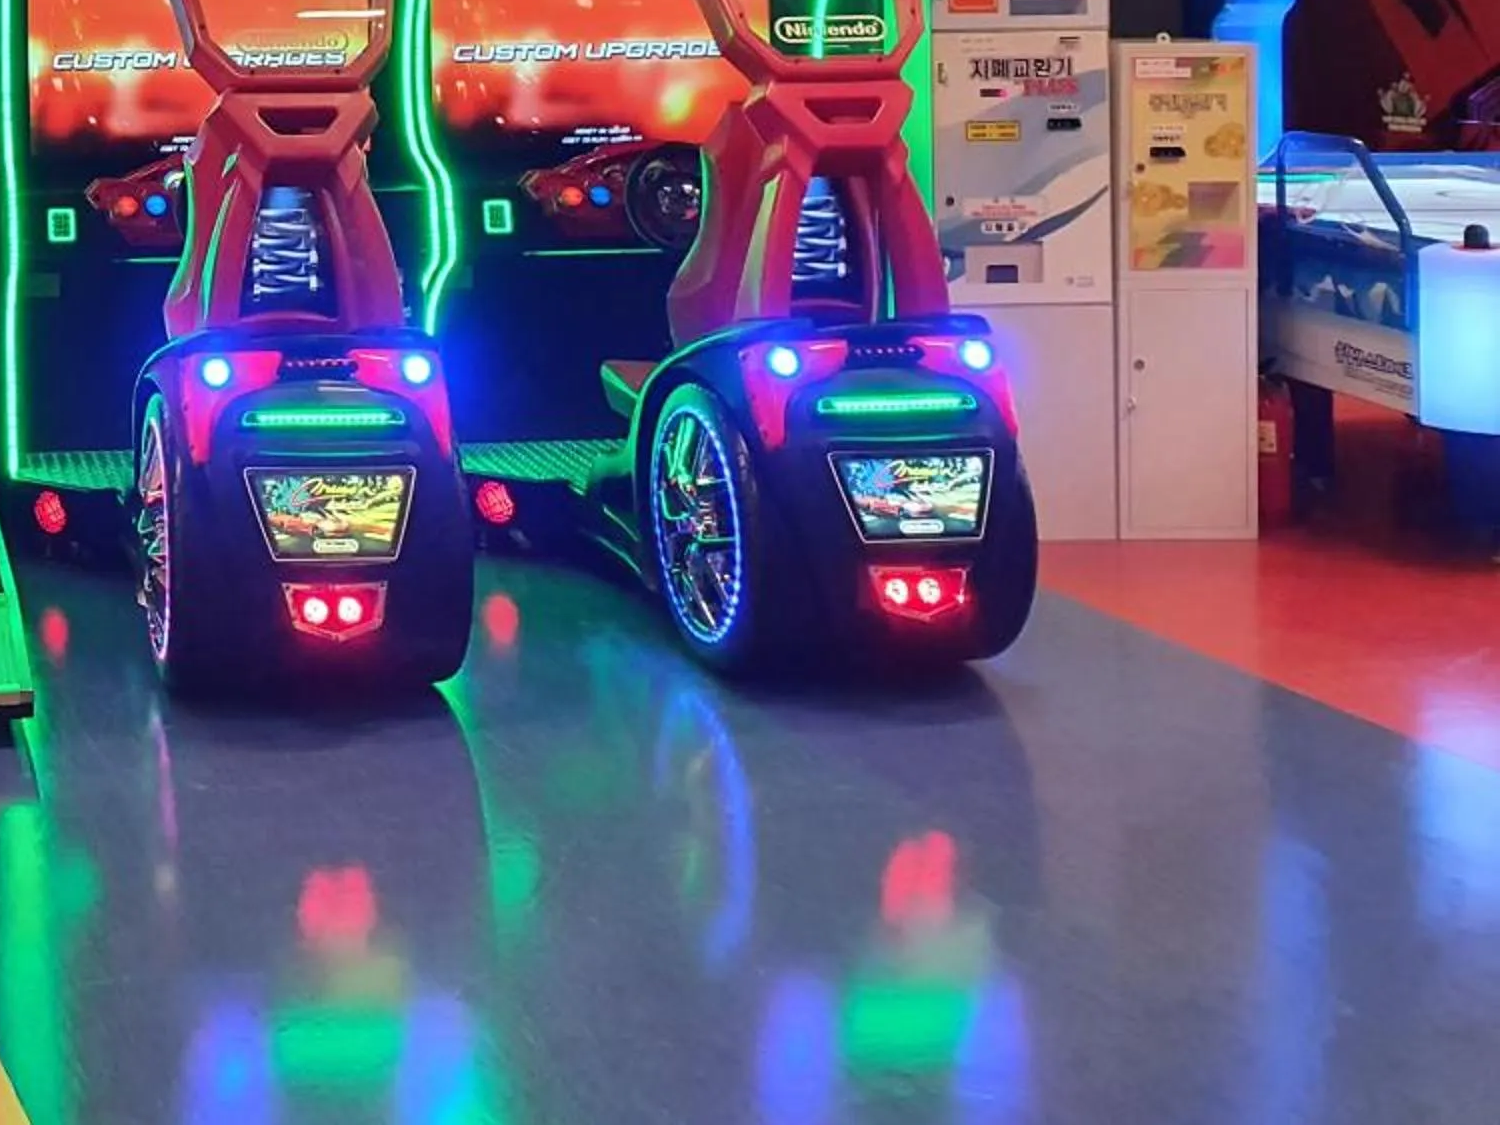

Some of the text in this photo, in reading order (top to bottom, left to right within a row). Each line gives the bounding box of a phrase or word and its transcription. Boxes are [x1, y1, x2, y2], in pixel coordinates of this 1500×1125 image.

[784, 21, 878, 37] Ninendo
[53, 49, 345, 70] CUSTOM GRADES
[453, 40, 722, 62] CUSTOM UPGRADE
